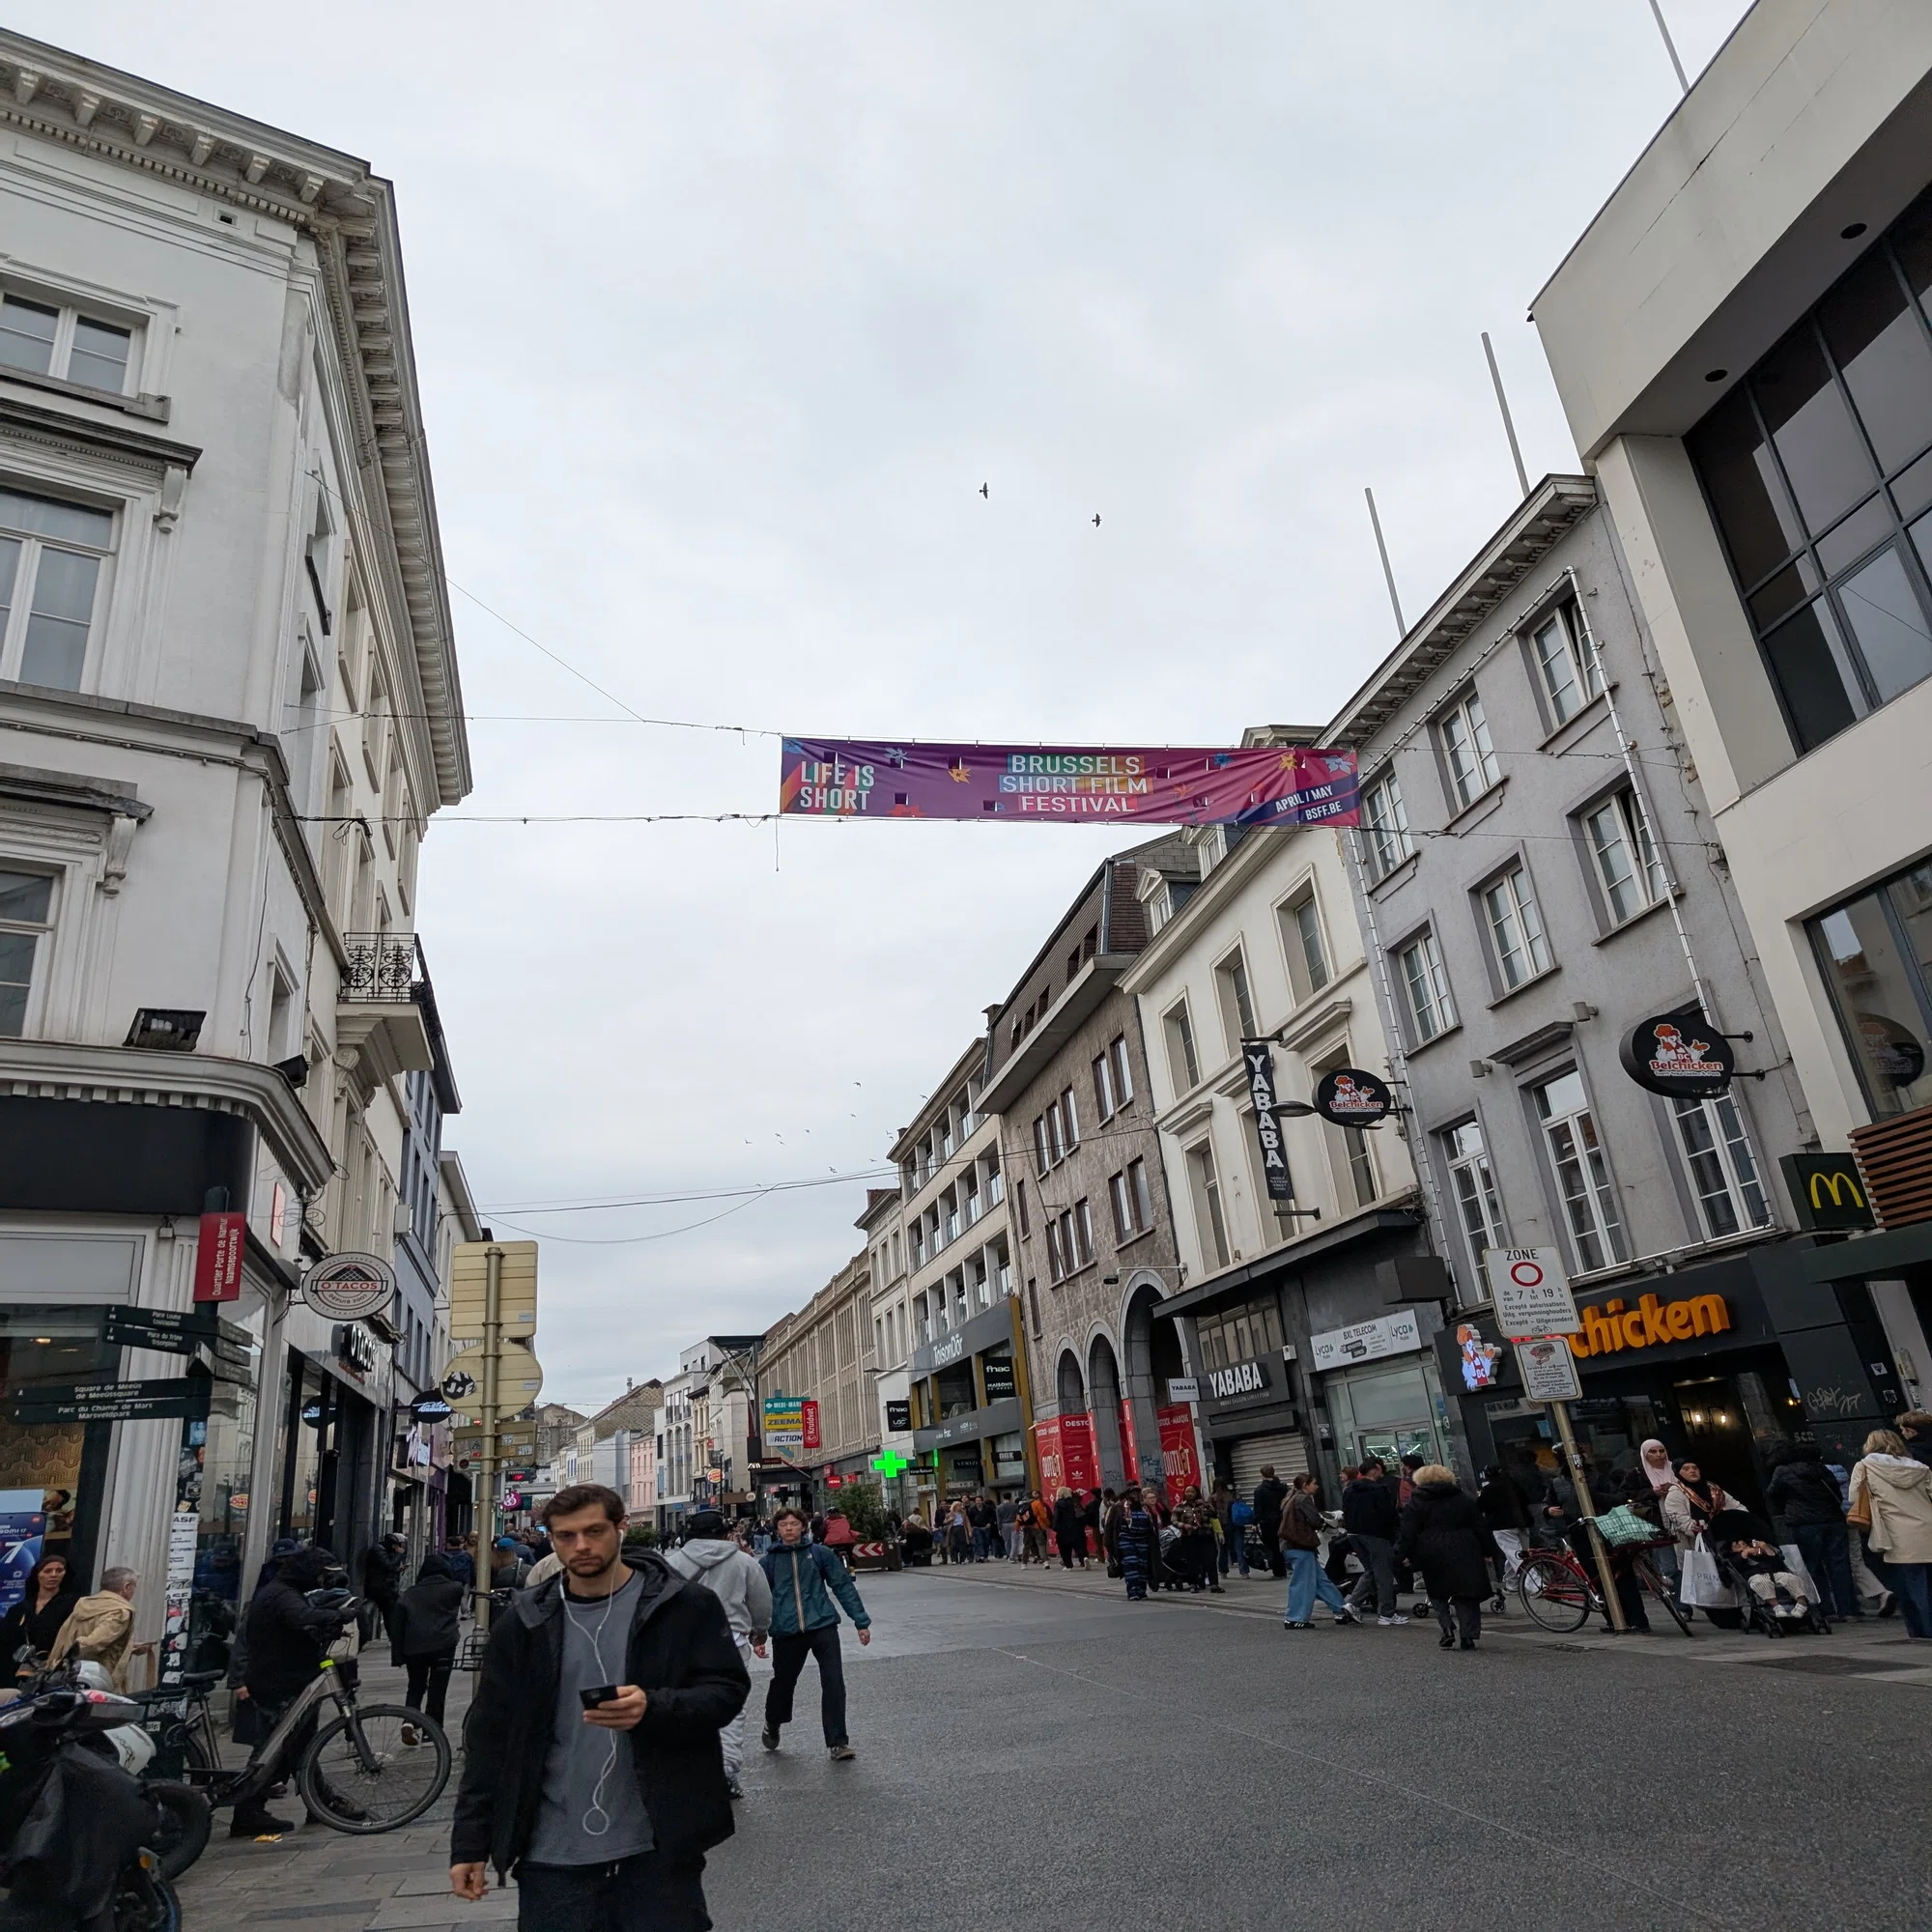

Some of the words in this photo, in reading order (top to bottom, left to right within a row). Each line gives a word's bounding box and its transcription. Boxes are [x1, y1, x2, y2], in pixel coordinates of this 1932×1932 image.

[1011, 754, 1140, 774] BRUSSELS
[801, 761, 846, 785] LIFE
[854, 765, 874, 787] IS
[1003, 776, 1080, 794] SHORT
[1091, 777, 1148, 794] FILM
[800, 786, 870, 810] SHORT
[1021, 796, 1135, 812] FESTIVAL
[1275, 792, 1305, 812] APRIL
[1312, 785, 1334, 800] MAY
[1305, 801, 1342, 820] BSFF.BE
[1649, 1060, 1724, 1071] Belchicken
[1247, 1054, 1284, 1168] YABABA
[218, 1218, 228, 1238] Namur
[217, 1240, 226, 1248] de
[215, 1250, 225, 1268] Porte
[1505, 1249, 1539, 1261] ZONE
[213, 1270, 223, 1296] Quartier
[328, 1293, 351, 1304] DEPUIS
[1517, 1290, 1523, 1299] 7
[1543, 1288, 1554, 1298] 19
[1518, 1308, 1571, 1317] vergunninghouders
[1536, 1316, 1573, 1324] Uitgezonderd
[1353, 1324, 1377, 1337] TELECOM
[1568, 1293, 1731, 1358] chicken
[1209, 1362, 1263, 1398] YABABA
[1476, 1368, 1485, 1378] BC
[78, 1411, 131, 1419] Marsveldpark
[806, 1408, 815, 1434] Kruidvat
